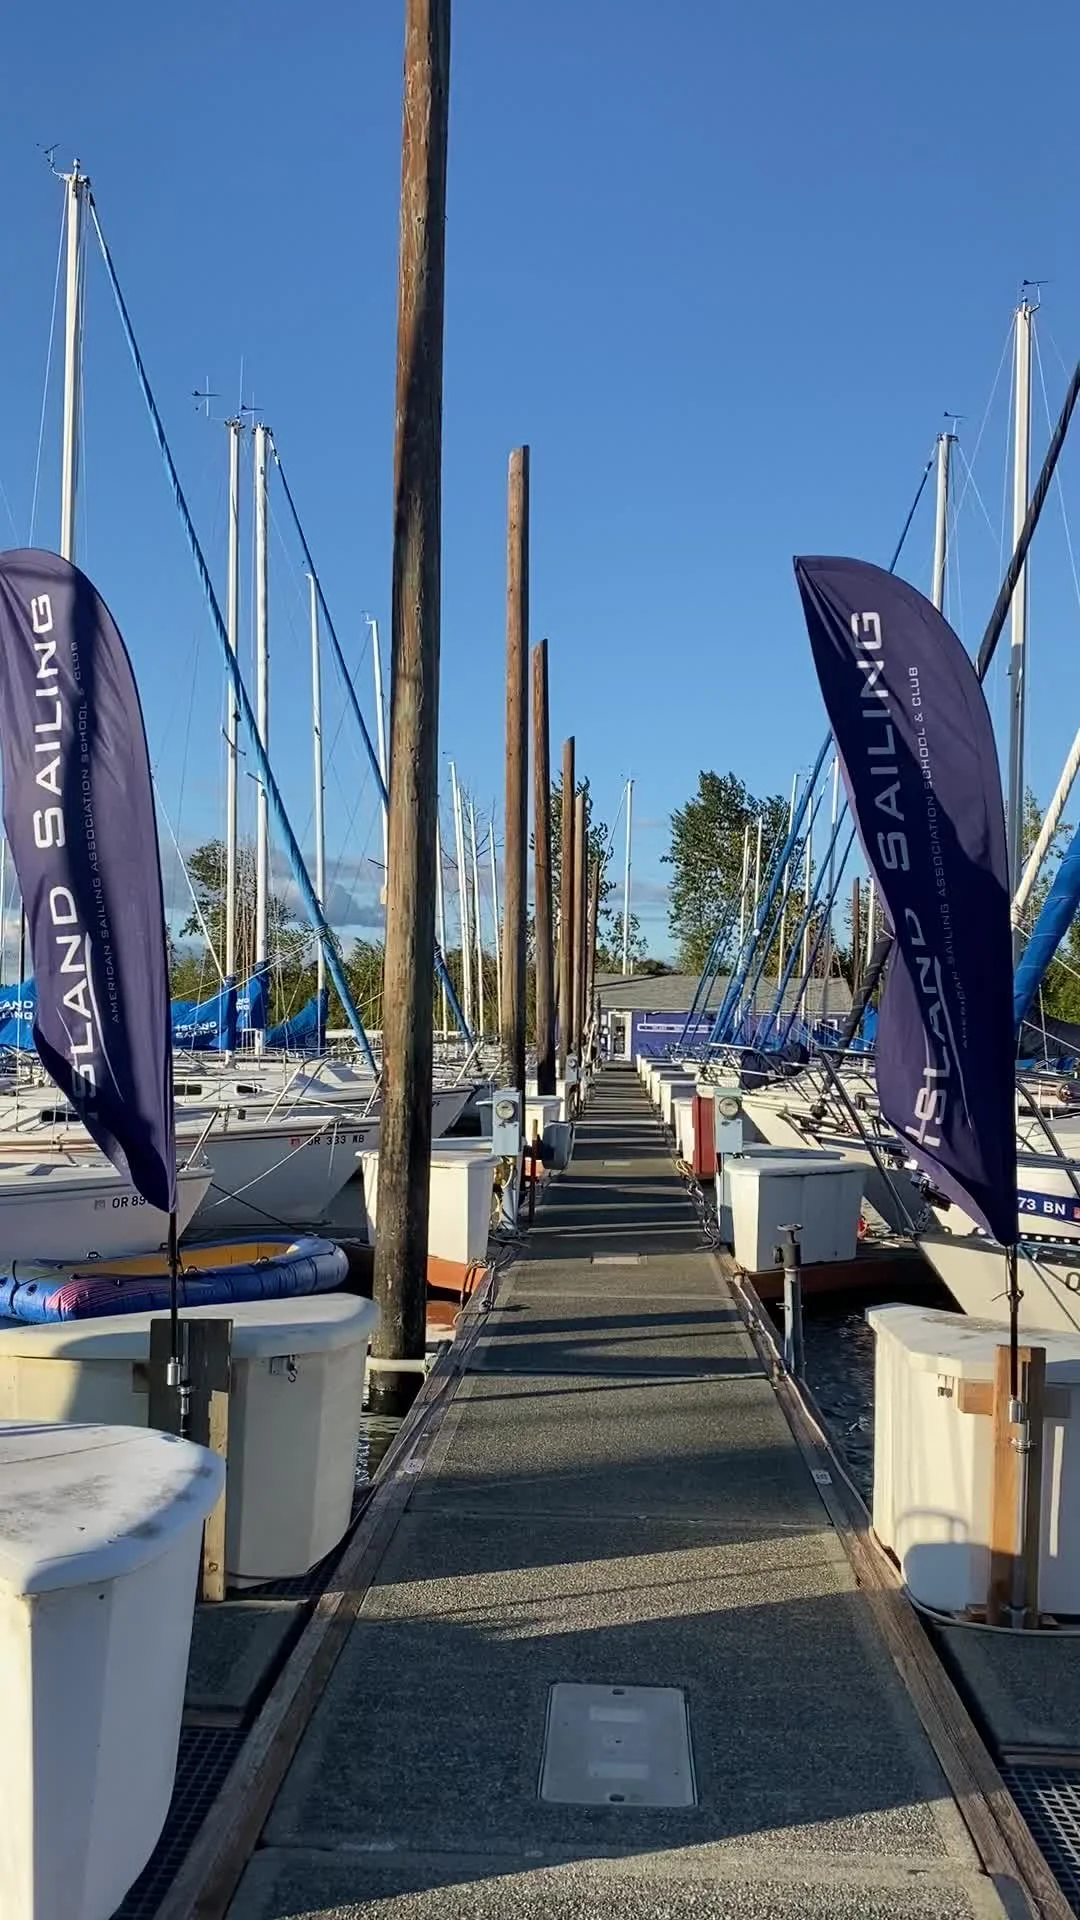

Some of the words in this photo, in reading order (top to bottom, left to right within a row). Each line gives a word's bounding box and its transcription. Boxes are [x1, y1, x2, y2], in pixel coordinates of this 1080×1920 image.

[908, 666, 922, 706] CLUB
[914, 711, 923, 722] &
[31, 593, 66, 849] SAILING
[79, 702, 89, 763] SCHOOL
[851, 611, 910, 872] SAILING
[918, 727, 933, 790] SCHOOL
[81, 769, 100, 872] ASSOCIATION
[925, 796, 947, 897] ASSOCIATION
[92, 877, 109, 939] SAILING
[102, 945, 120, 1024] AMERICAN
[905, 907, 951, 1147] ISLAND
[112, 1197, 128, 1209] OR
[1043, 1200, 1066, 1216] BN
